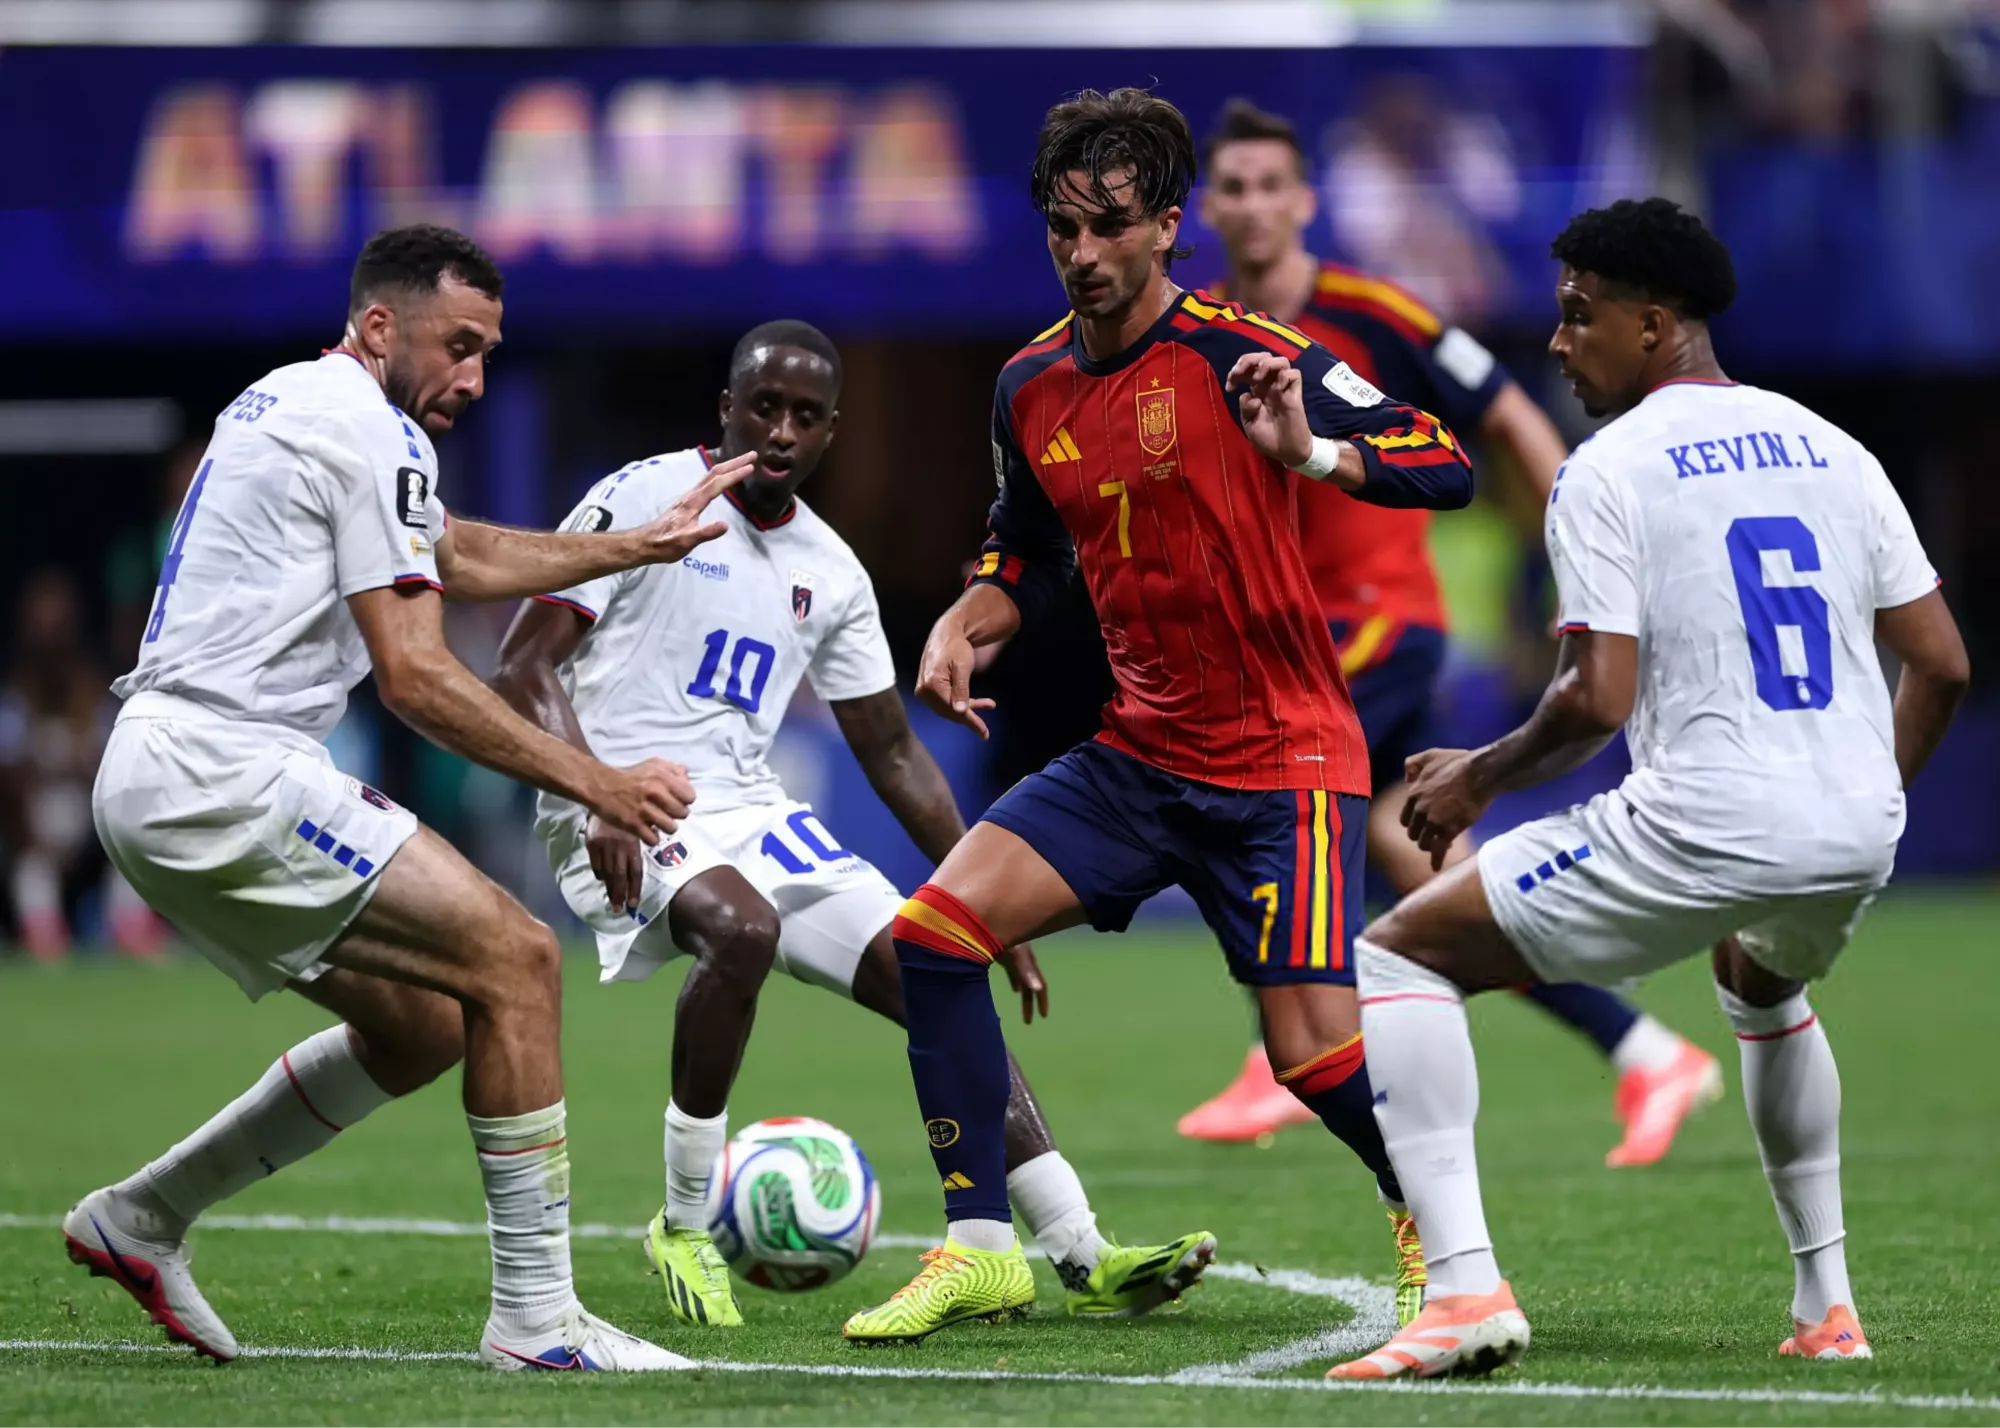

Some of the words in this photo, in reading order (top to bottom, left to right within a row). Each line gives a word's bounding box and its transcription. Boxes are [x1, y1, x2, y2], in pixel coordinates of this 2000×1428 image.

[1098, 480, 1132, 558] 7
[683, 557, 729, 578] capelli
[1725, 516, 1833, 712] 6
[686, 628, 776, 714] 10
[760, 810, 853, 874] 10
[1252, 883, 1278, 964] 7
